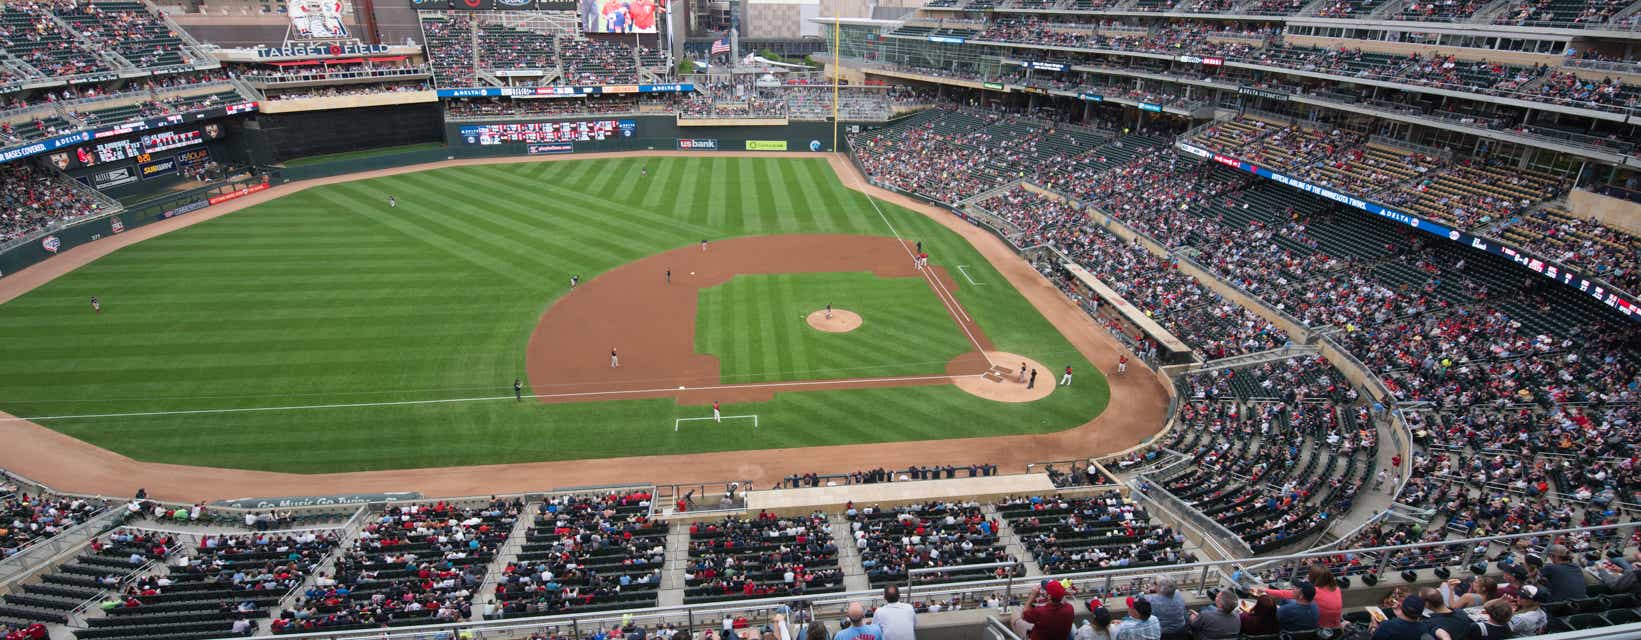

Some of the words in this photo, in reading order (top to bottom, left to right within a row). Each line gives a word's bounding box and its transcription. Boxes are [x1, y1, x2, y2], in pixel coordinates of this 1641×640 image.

[257, 46, 329, 58] TARGET
[344, 43, 389, 55] FIELD
[61, 136, 81, 145] DELTA
[4, 148, 22, 160] BASES
[144, 162, 173, 174] SUBWAY
[1305, 183, 1312, 192] OF
[1311, 185, 1321, 195] THE
[1321, 188, 1349, 204] MINNESOTA
[1386, 210, 1409, 223] DELTA
[280, 498, 314, 508] Music
[317, 498, 335, 506] Go
